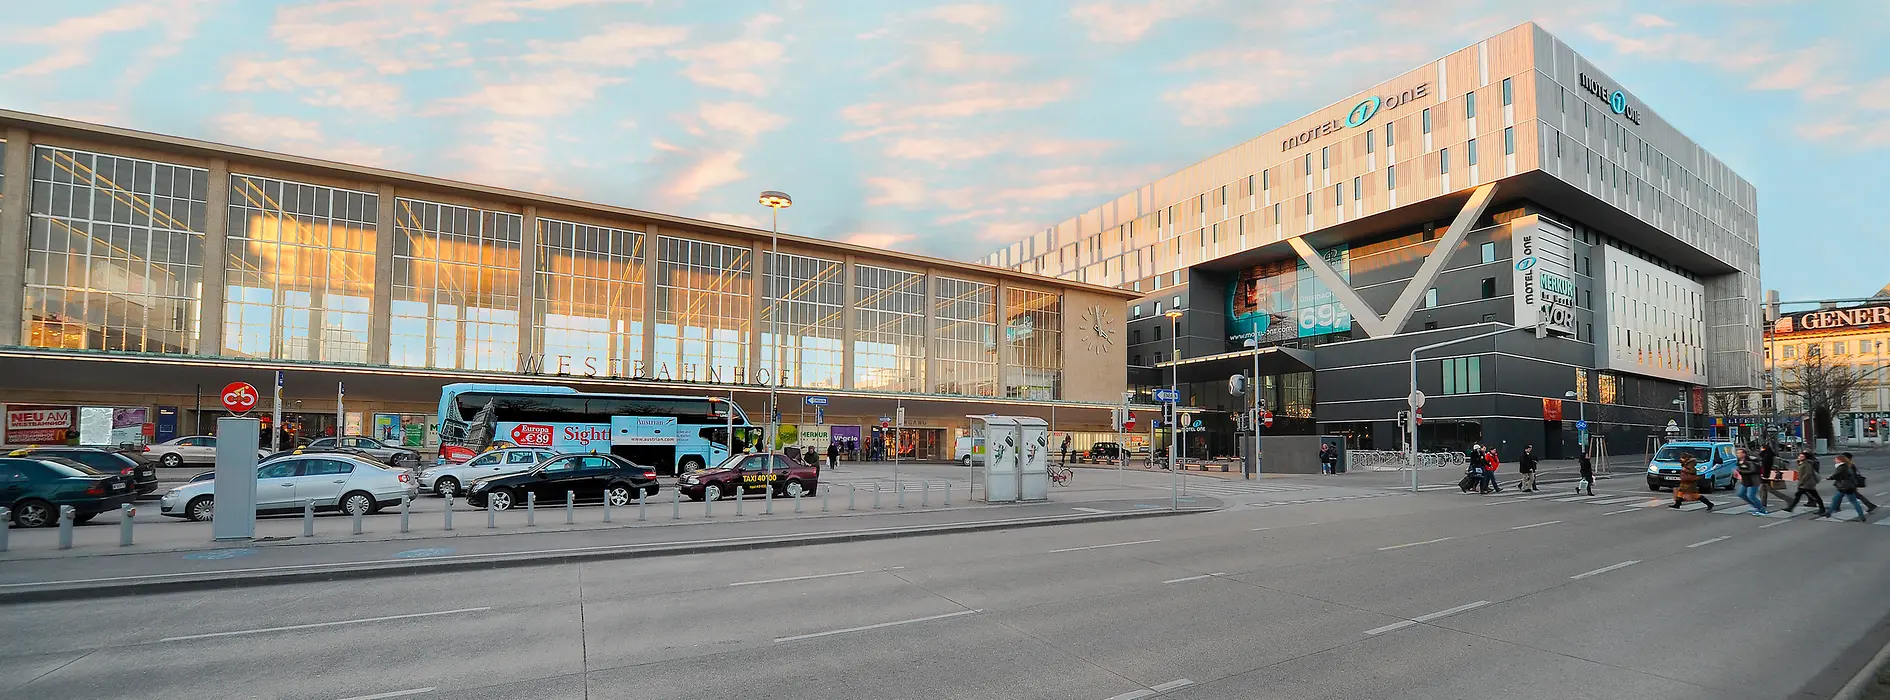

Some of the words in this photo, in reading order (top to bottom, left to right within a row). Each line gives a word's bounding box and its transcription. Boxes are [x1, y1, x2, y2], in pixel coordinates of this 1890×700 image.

[1281, 119, 1342, 152] MOTEL
[1385, 81, 1429, 110] ONE
[1523, 235, 1532, 255] ONE
[1524, 269, 1534, 305] MOTEL
[1540, 272, 1574, 297] MERKUR
[1801, 306, 1890, 330] GENER
[518, 352, 790, 386] WESTBAHNHOF
[11, 412, 43, 422] NEU
[46, 411, 68, 421] AM
[522, 424, 549, 435] Europa
[742, 474, 757, 483] TAXI
